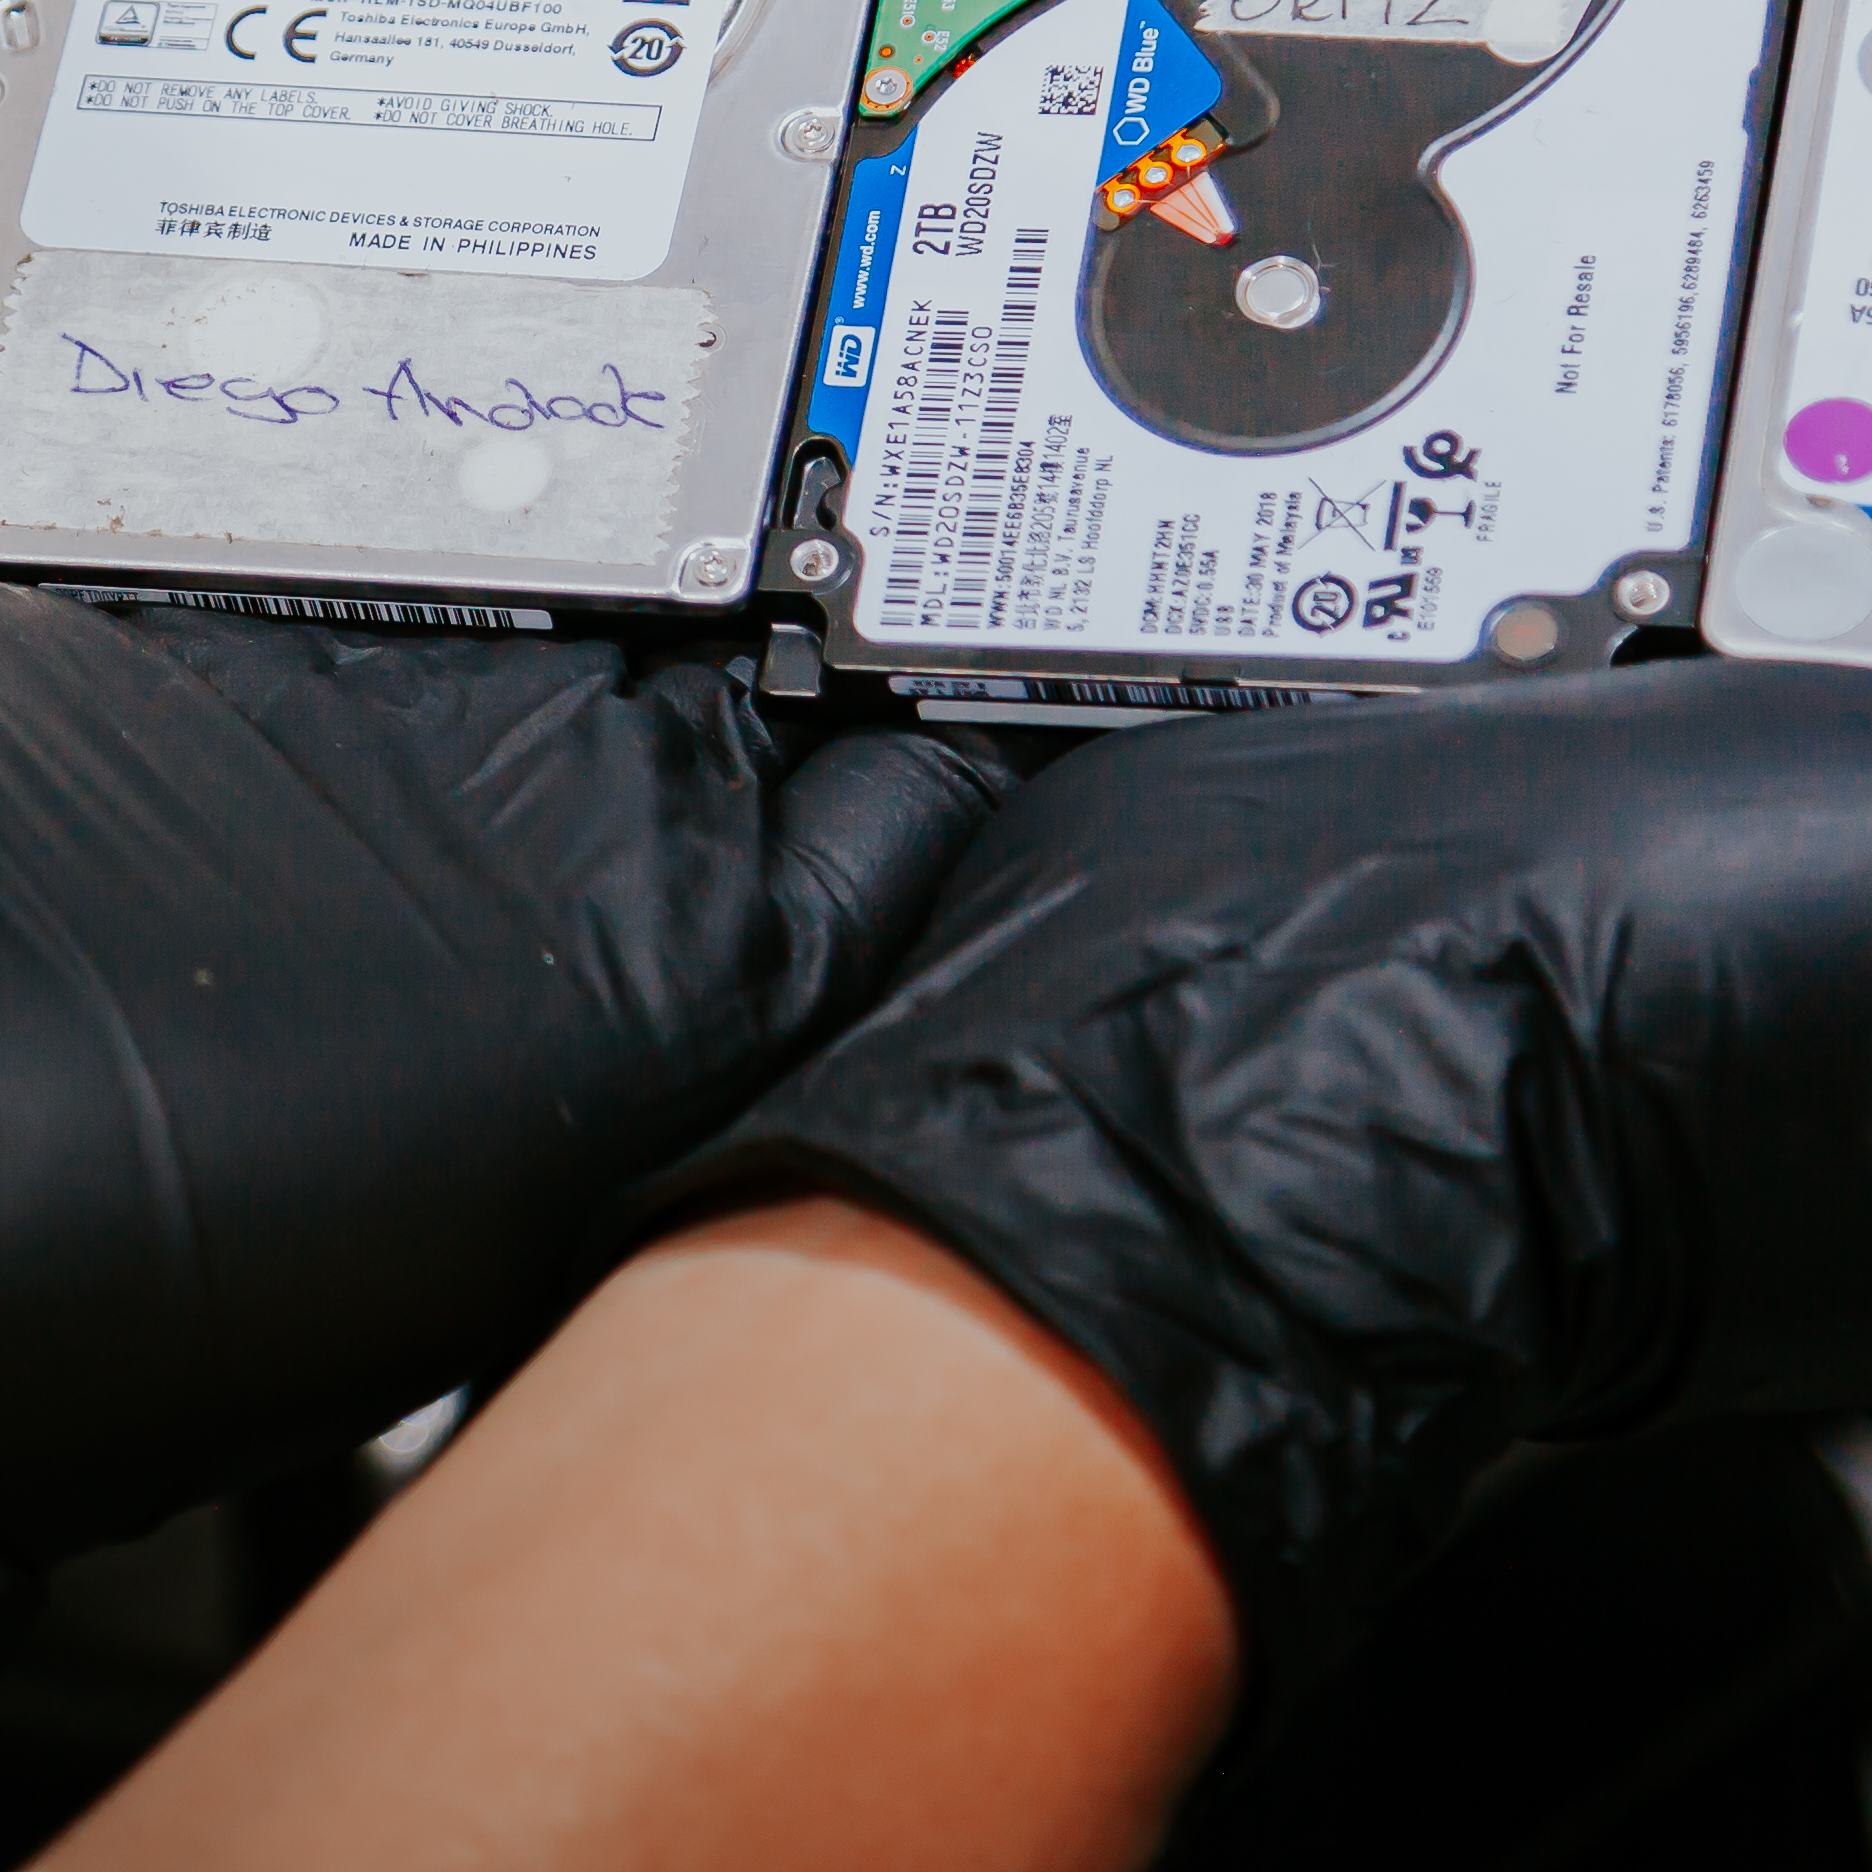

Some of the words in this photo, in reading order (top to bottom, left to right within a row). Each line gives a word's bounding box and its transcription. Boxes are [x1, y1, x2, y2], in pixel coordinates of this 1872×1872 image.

[338, 11, 397, 24] Toshiba
[400, 14, 480, 29] Electronics
[483, 18, 537, 35] Europe
[448, 37, 490, 50] 40549
[328, 50, 395, 67] Germany
[122, 80, 153, 96] NOT
[160, 83, 215, 98] REMOVE
[223, 87, 253, 100] ANY
[1125, 77, 1150, 114] WD
[119, 94, 149, 108] NOT
[156, 96, 195, 111] PUSH
[201, 99, 222, 112] ON
[229, 100, 257, 114] THE
[265, 102, 294, 116] TOP
[439, 98, 498, 114] GIVING
[408, 110, 438, 124] NOT
[445, 112, 494, 127] COVER
[500, 115, 585, 133] BREATHING
[591, 120, 634, 135] HOLE.
[156, 201, 227, 218] TOSHIBA
[227, 205, 326, 222] ELECTRONIC
[328, 211, 397, 226] DEVICES
[398, 215, 410, 226] &
[412, 216, 484, 231] STORAGE
[487, 220, 600, 237] CORPORATION
[348, 231, 412, 250] MADE
[422, 236, 445, 251] IN
[455, 237, 597, 260] PHILIPPINES
[852, 209, 881, 310] www.wd.com
[835, 334, 863, 378] WD
[62, 332, 340, 424] Diego
